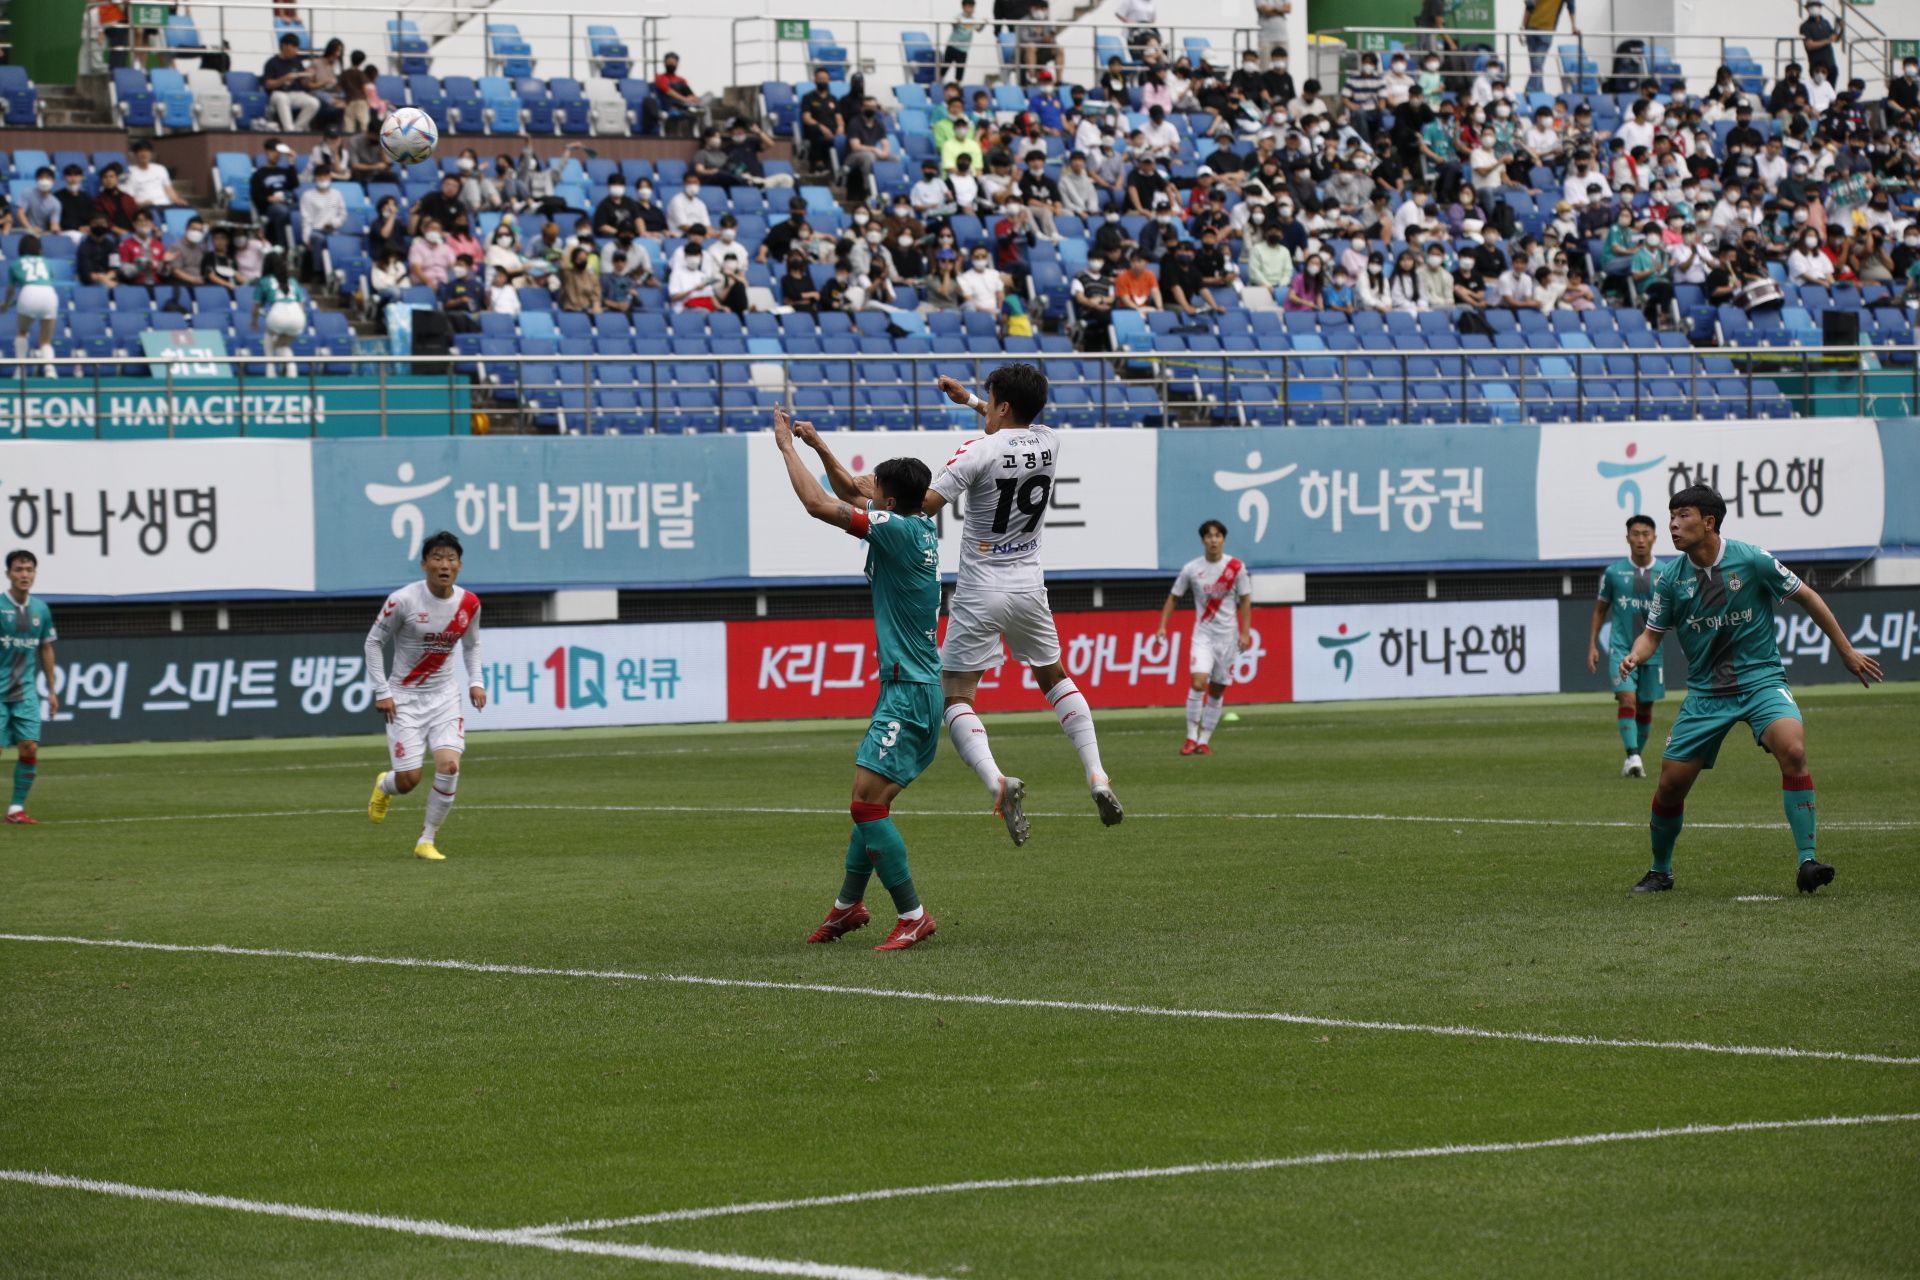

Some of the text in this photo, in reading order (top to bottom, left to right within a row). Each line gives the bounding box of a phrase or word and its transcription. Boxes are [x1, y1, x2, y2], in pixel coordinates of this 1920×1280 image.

[111, 396, 326, 427] HANACITIZEN
[1003, 449, 1052, 469] 고경민
[455, 482, 700, 550] 하나캐피탈
[992, 474, 1052, 534] 19
[1300, 467, 1484, 532] 하나증권
[1668, 457, 1825, 519] 하나은행
[9, 486, 217, 556] 하나생명
[1380, 624, 1527, 676] 하나은행
[1850, 610, 1920, 661] 스마
[143, 659, 278, 716] 스마트
[616, 658, 681, 701] 원큐
[758, 641, 878, 696] K리그
[1068, 633, 1181, 687] 하나의
[881, 721, 900, 747] 3
